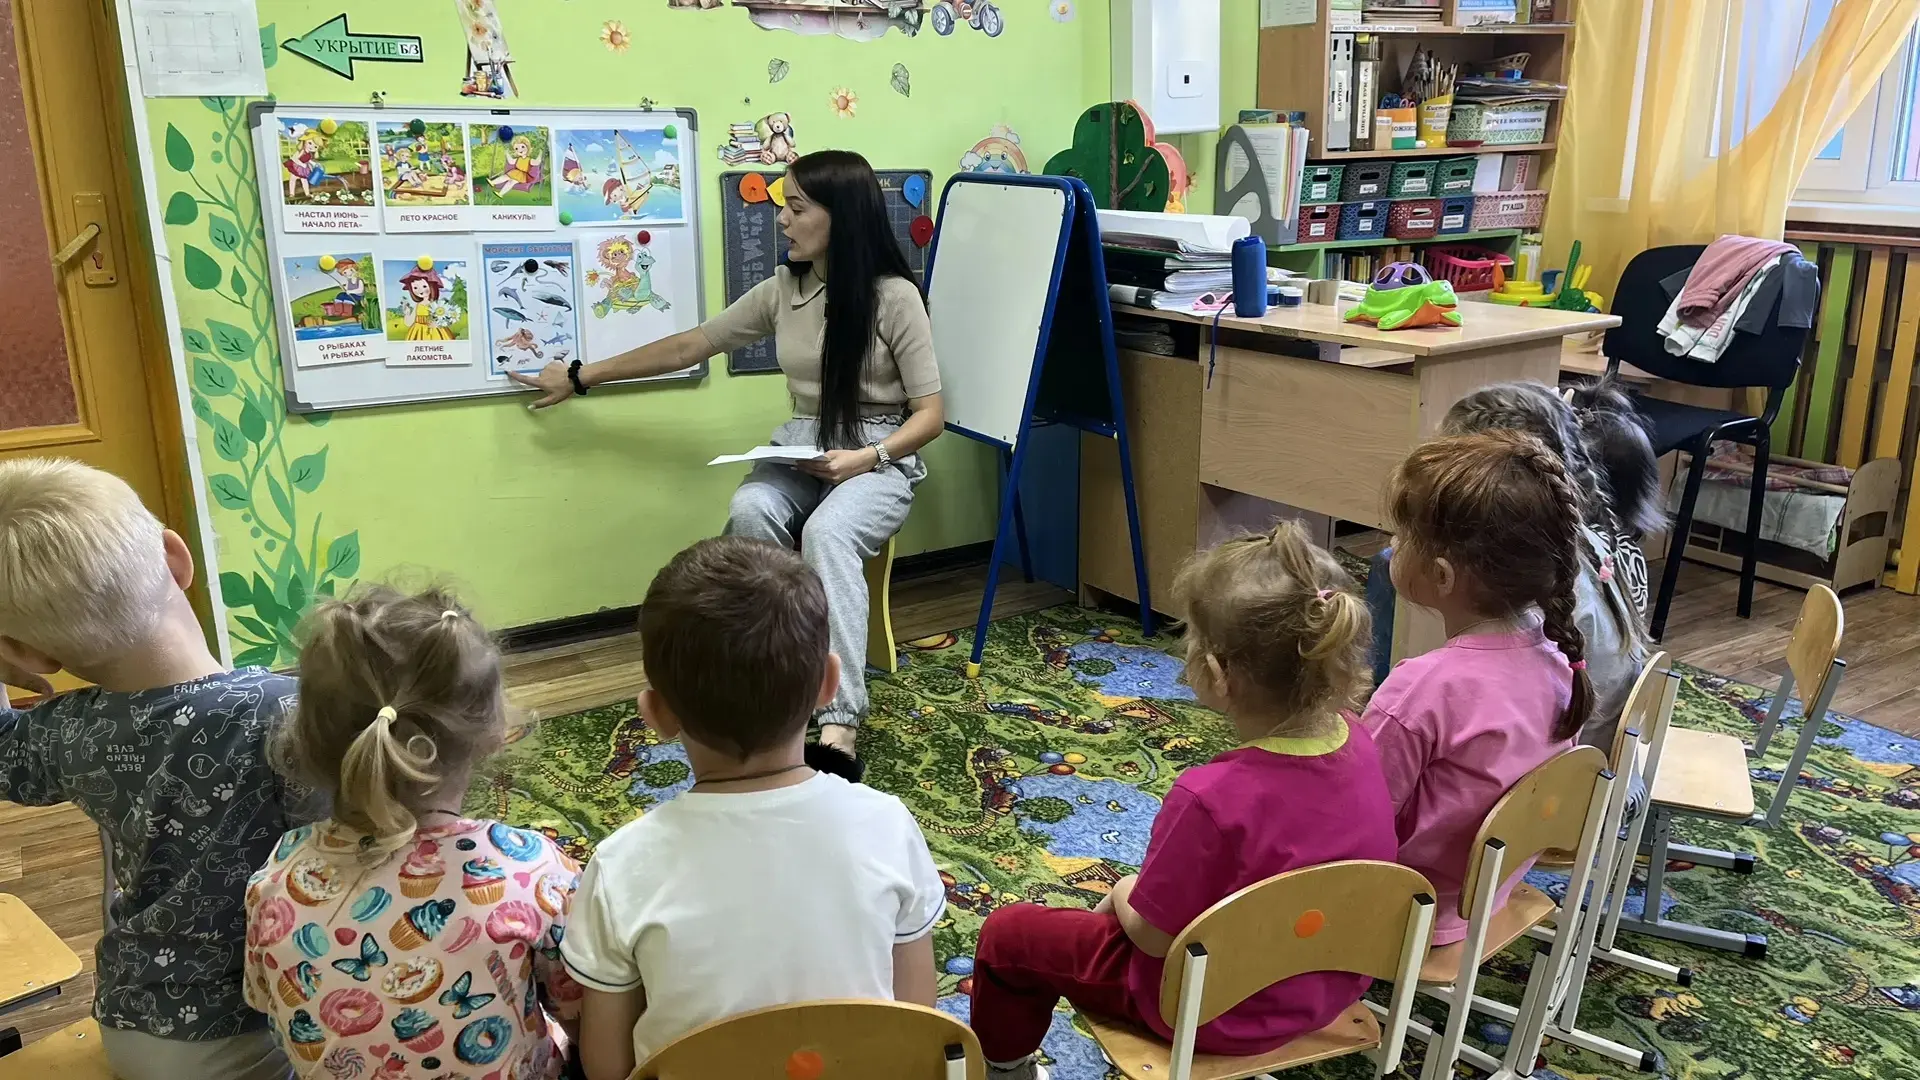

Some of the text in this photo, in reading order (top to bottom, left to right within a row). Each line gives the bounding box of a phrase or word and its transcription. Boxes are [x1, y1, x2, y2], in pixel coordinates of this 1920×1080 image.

[313, 39, 397, 56] УКРЫТИЕ
[1501, 203, 1525, 212] ГУАШЬ
[294, 211, 332, 219] «НАСТАЛ
[333, 211, 359, 219] ИЮНЬ
[399, 213, 458, 222] ЛЕТО КРАСНОЕ
[491, 213, 537, 221] КАНИКУЛЫ!
[301, 221, 336, 229] НАЧАЛО
[326, 340, 367, 351] РЫБАКАХ
[413, 345, 444, 353] ЛЕТНИЕ
[330, 350, 365, 360] РЫБКАХ
[406, 354, 453, 362] ЛАКОМСТВА
[105, 744, 135, 753] EVER
[105, 753, 146, 763] FRIEND
[113, 763, 142, 773] BEST
